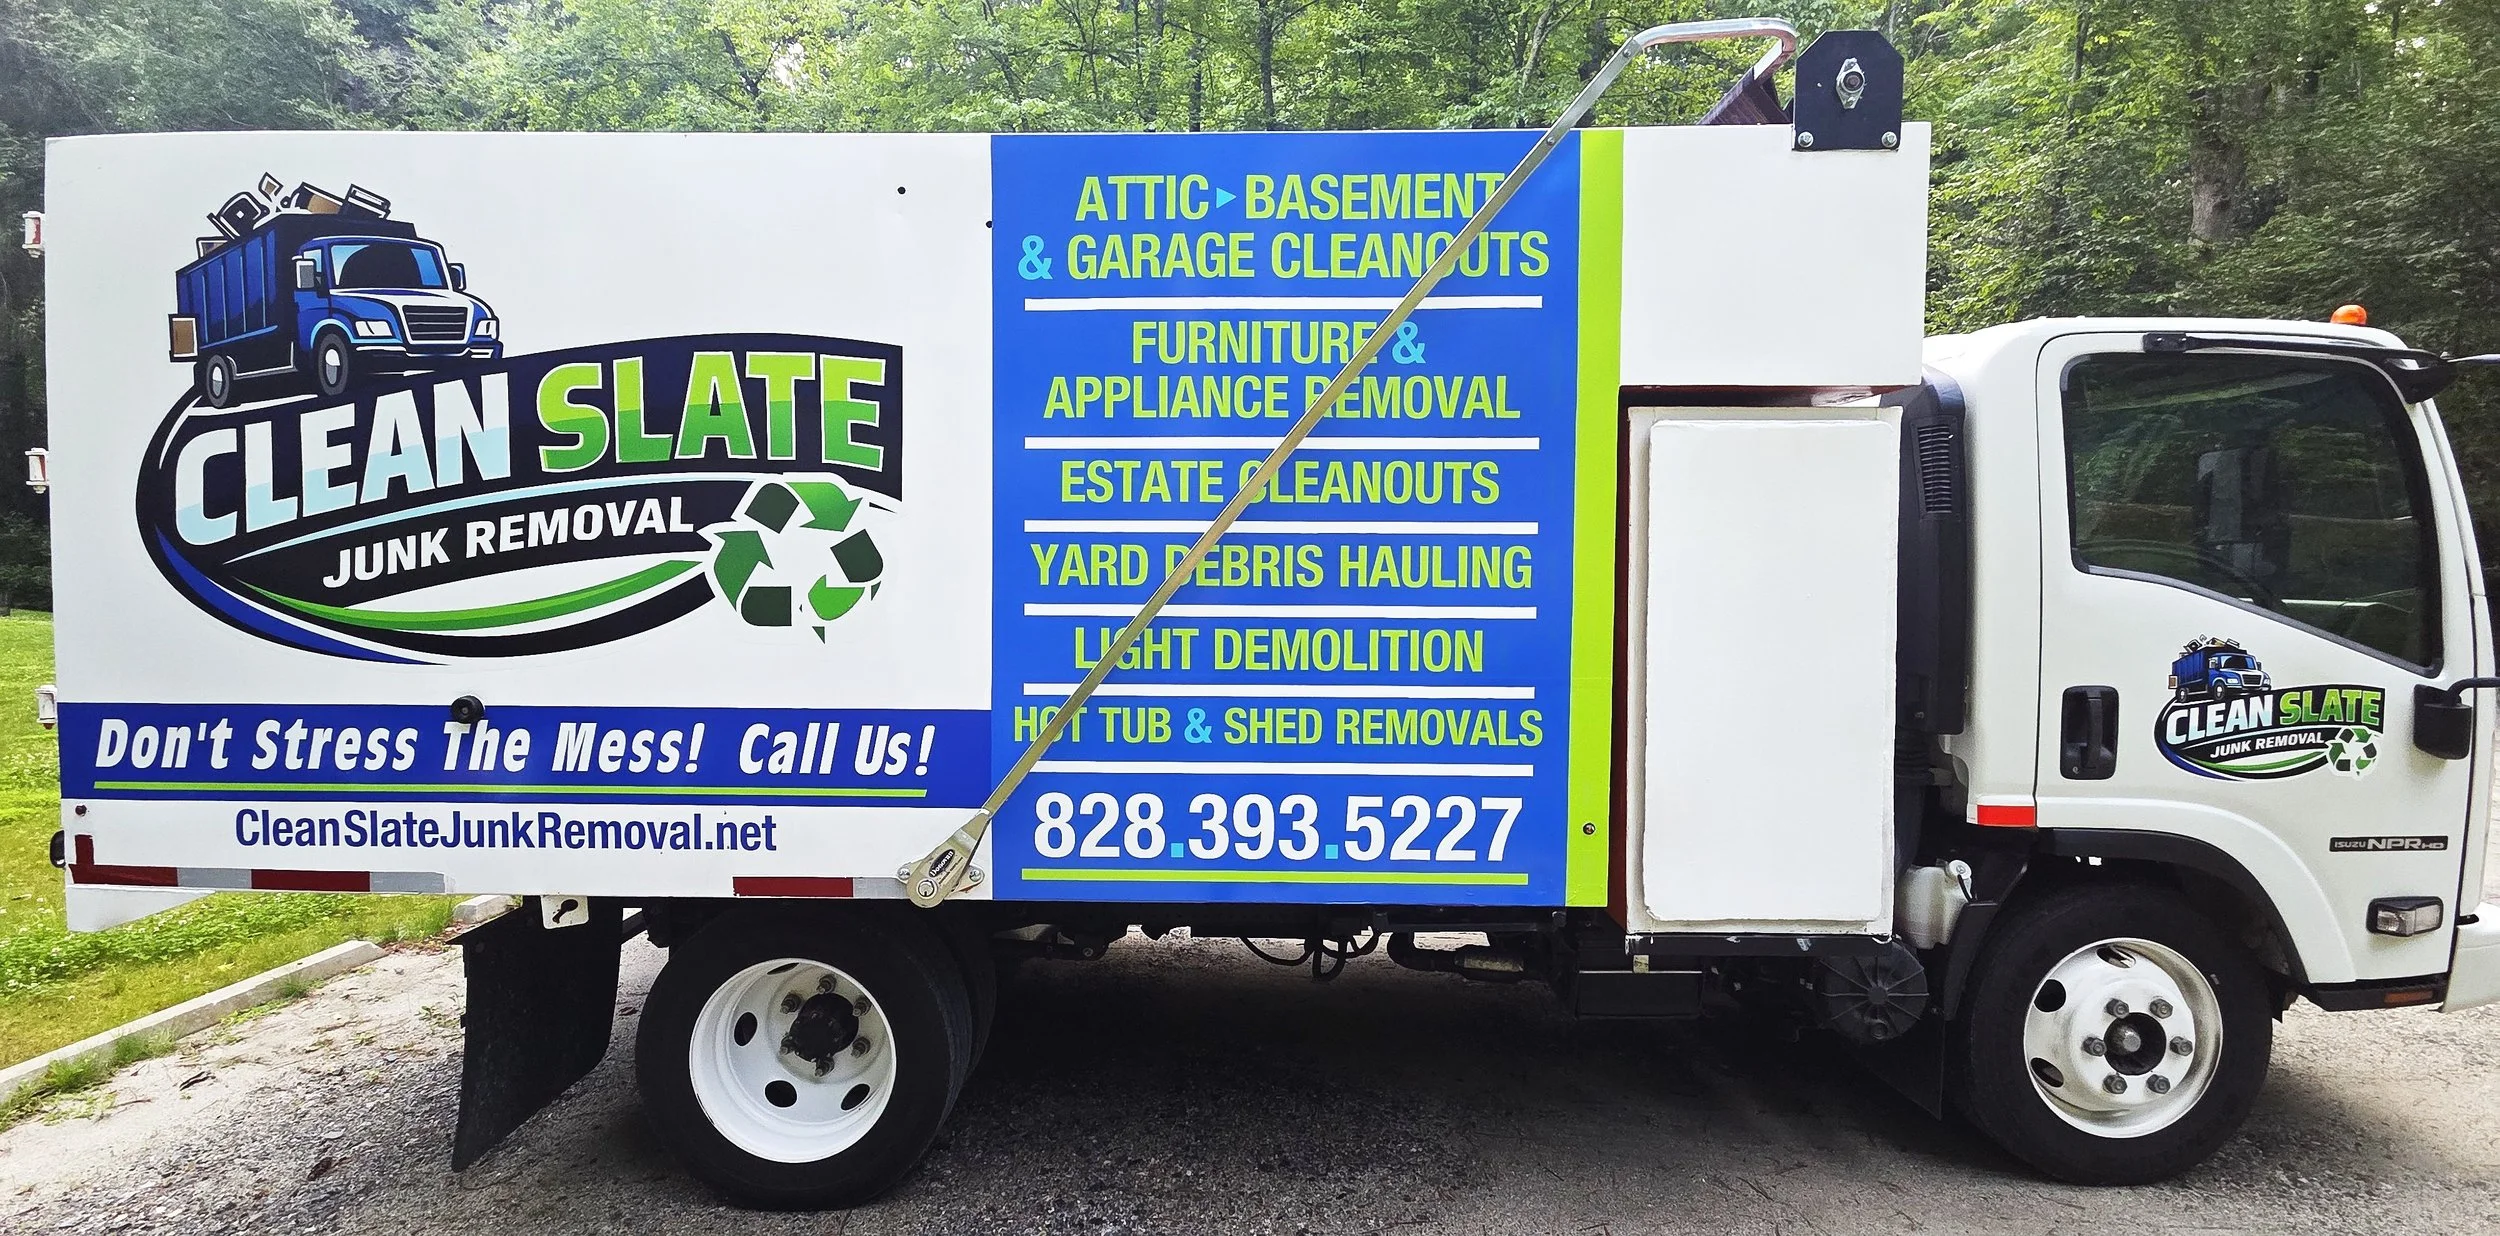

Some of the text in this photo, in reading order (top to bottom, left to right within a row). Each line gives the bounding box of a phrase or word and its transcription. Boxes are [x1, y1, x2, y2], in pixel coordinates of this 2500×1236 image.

[1076, 172, 1504, 221] ATTIC BASEMENT
[1018, 231, 1549, 280] & GARAGE CLEANOUTS
[1133, 320, 1426, 364] FURNITURE &
[1044, 375, 1521, 419] APPLIANCE REMOVAL
[176, 351, 886, 545] CLEAN SLATE
[1062, 460, 1499, 504] ESTATE CLEANOUTS
[323, 495, 694, 588] JUNK REMOVAL
[1031, 544, 1531, 589] YARD DEBRIS HAULING
[1075, 627, 1483, 672] LIGHT DEMOLITION
[1099, 707, 1171, 743] TUB
[1184, 707, 1212, 743] &
[1225, 708, 1322, 744] SHED
[1337, 709, 1543, 746] REMOVALS
[2166, 689, 2382, 745] CLEAN SLATE
[95, 718, 935, 776] Don't Stress The Mess! Call Us!
[2210, 732, 2325, 759] JUNK REMOVAL
[235, 808, 777, 851] CleanSlateJunkRemoval.net
[1034, 792, 1523, 862] 828.393.5227
[2334, 841, 2366, 849] ISUZU
